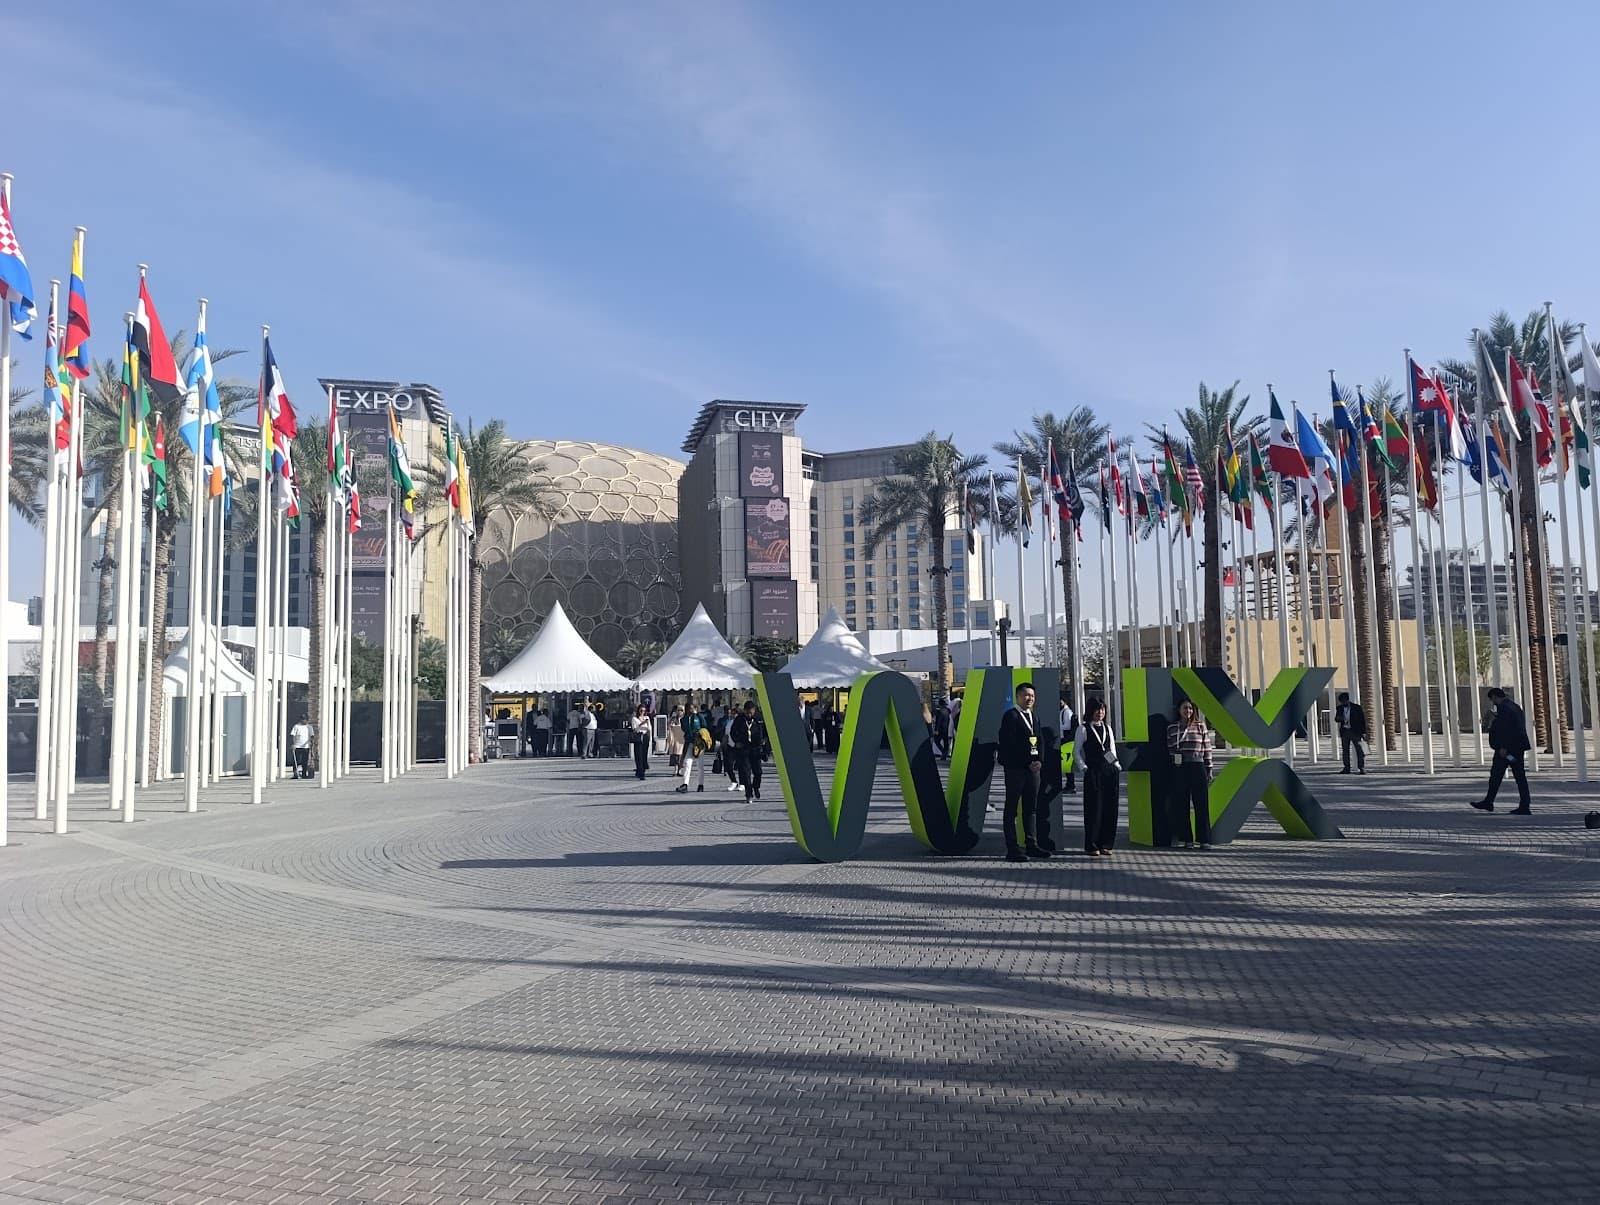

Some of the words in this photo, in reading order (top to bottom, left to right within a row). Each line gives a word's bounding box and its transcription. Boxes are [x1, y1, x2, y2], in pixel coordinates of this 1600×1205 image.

[336, 389, 413, 411] EXPO
[734, 409, 786, 429] CITY
[753, 667, 1344, 863] WHX
